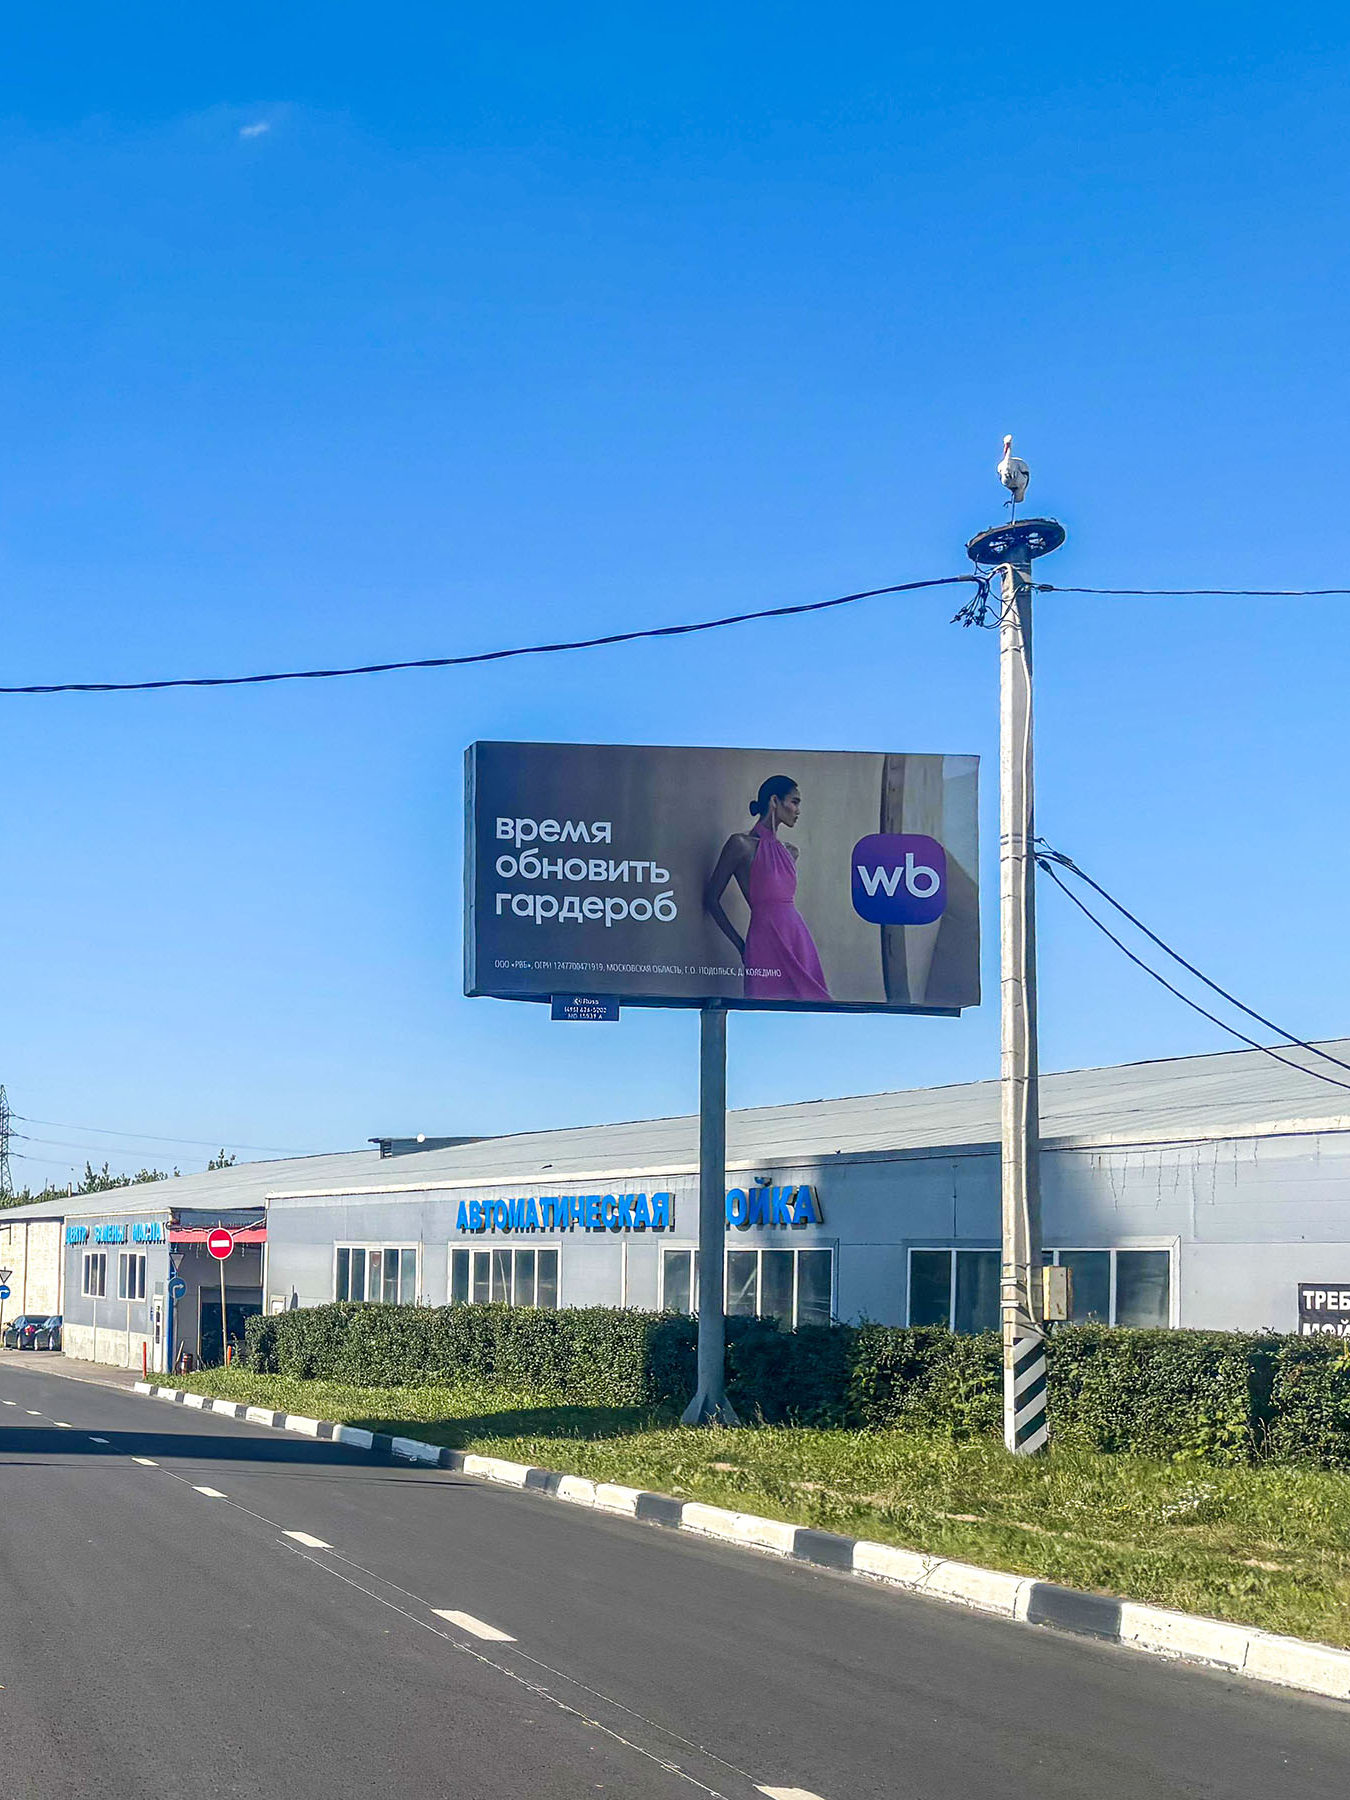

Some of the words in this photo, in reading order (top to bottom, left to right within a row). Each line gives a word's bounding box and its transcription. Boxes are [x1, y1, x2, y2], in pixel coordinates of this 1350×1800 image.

[496, 817, 612, 848] время
[495, 847, 670, 884] обновить
[857, 852, 940, 898] wb
[495, 890, 677, 927] гардероб
[494, 959, 510, 969] ООО
[534, 960, 552, 970] ОГРН
[606, 963, 652, 973] МОСКОВСКАЯ
[456, 1192, 673, 1230] АВТОМАТИЧЕСКАЯ
[725, 1176, 820, 1227] ОЙКА
